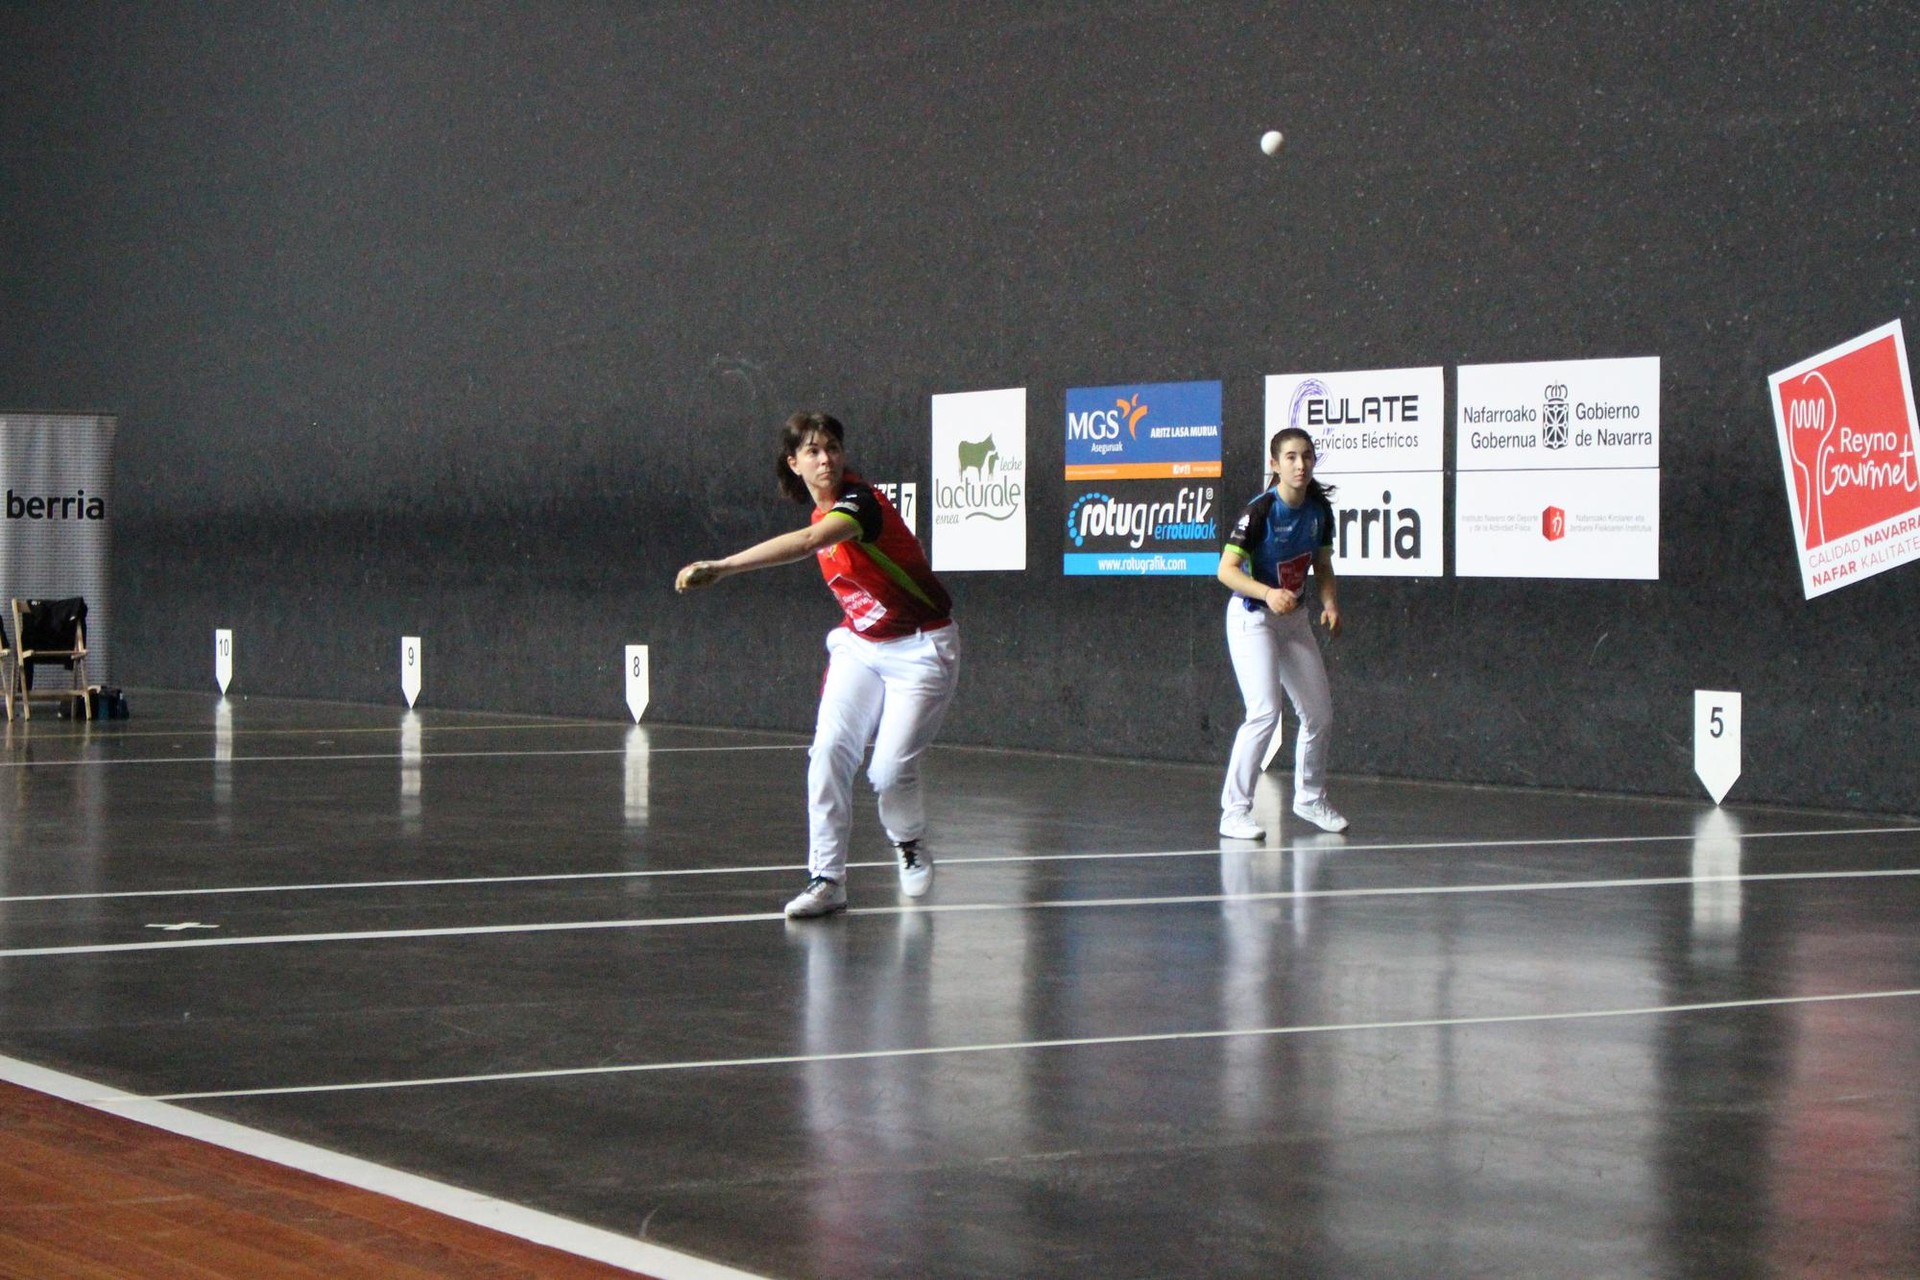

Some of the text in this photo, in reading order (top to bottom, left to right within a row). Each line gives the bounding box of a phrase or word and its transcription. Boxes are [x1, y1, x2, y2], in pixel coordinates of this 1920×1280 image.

[1307, 395, 1419, 425] EULATE
[1464, 406, 1537, 424] Nafarroako
[1576, 402, 1640, 421] Gobierno
[1068, 410, 1119, 440] MGS
[1150, 426, 1218, 439] ARITZ LASA MURUA
[1311, 432, 1419, 450] ervicios Eléctricos
[1471, 431, 1537, 449] Gobernua
[1575, 429, 1652, 446] de Navarra
[1840, 427, 1897, 458] Reyno
[1000, 456, 1022, 472] leche
[1822, 434, 1919, 496] Gourmet
[935, 476, 1021, 508] lacturale
[6, 489, 105, 520] berria
[904, 493, 913, 518] 7
[935, 514, 960, 524] esnea
[1154, 518, 1216, 540] errotuloak
[1808, 539, 1861, 569] CALIDAD
[1098, 557, 1187, 574] www.rotugrafik.com
[1812, 560, 1858, 588] NAFAR
[218, 637, 230, 657] 10
[408, 646, 415, 666] 9
[633, 656, 640, 678] 8
[1709, 706, 1724, 738] 5
